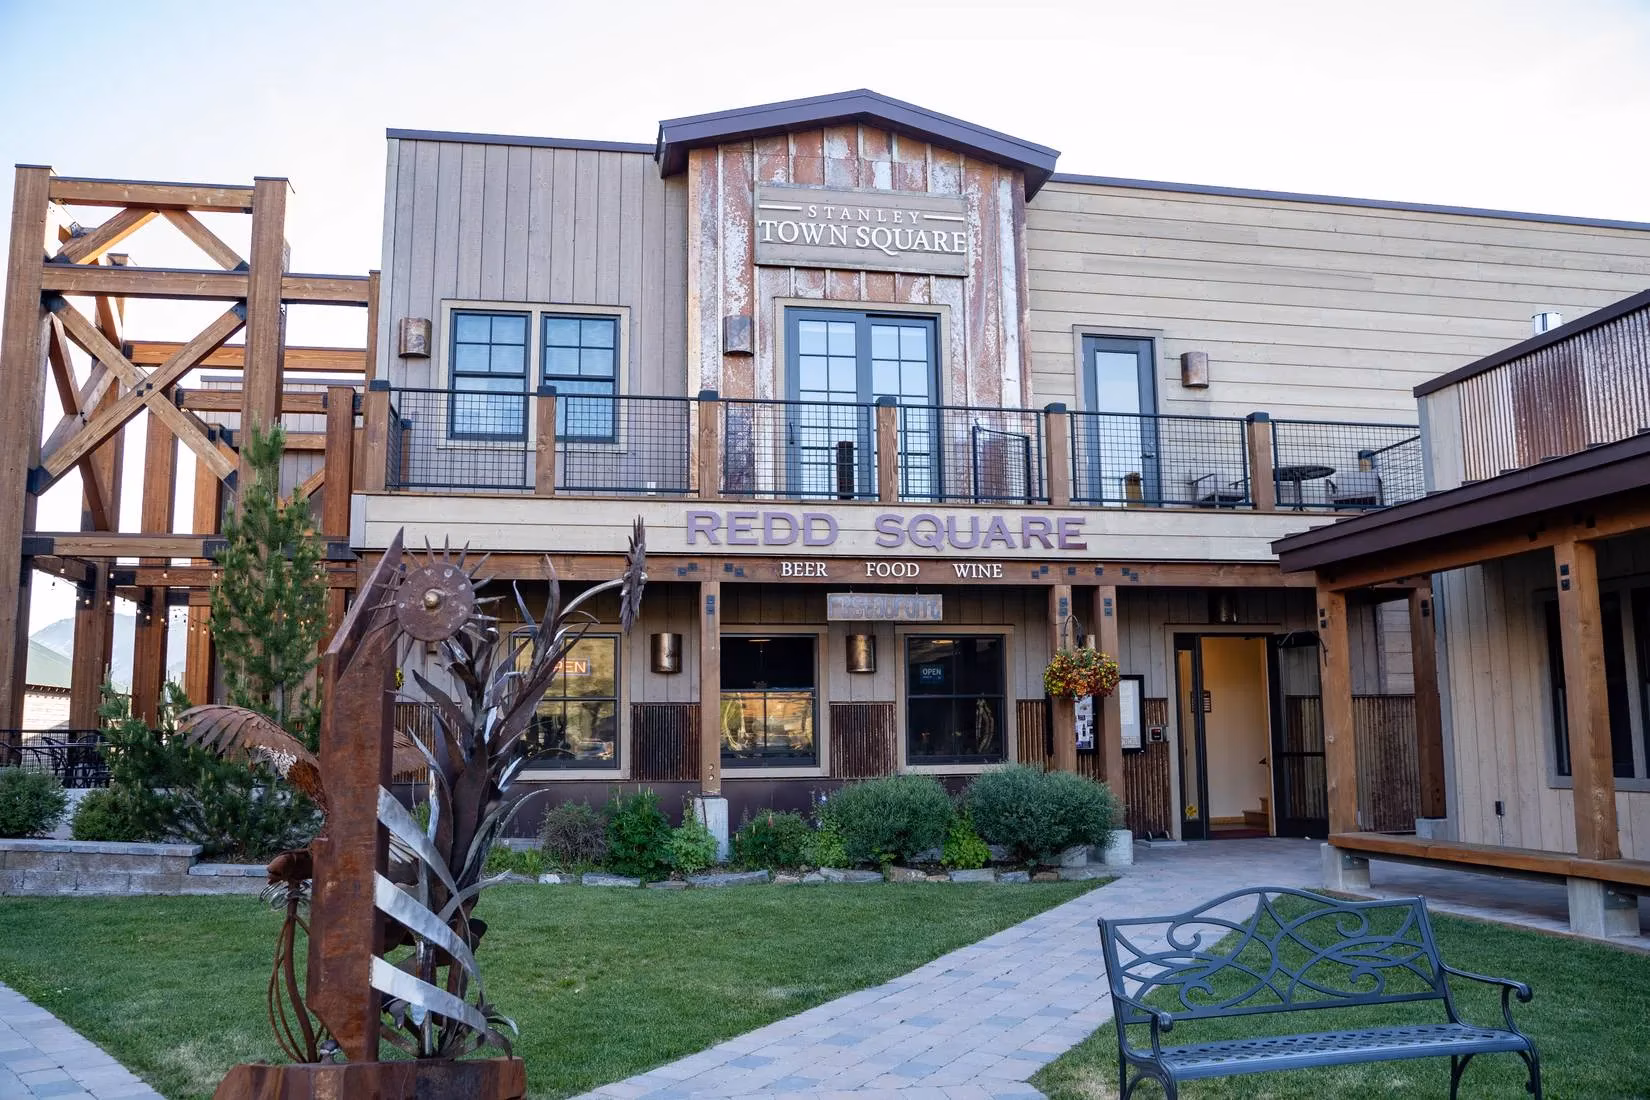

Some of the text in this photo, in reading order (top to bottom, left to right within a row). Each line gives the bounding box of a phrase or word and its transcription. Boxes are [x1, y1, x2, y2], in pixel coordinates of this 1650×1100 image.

[808, 205, 920, 225] STANLEY
[759, 219, 968, 256] TOWN SQUARE
[686, 510, 1088, 552] REDD SQUARE
[780, 562, 1003, 579] BEER FOOD WINE
[922, 668, 942, 676] OPEN
